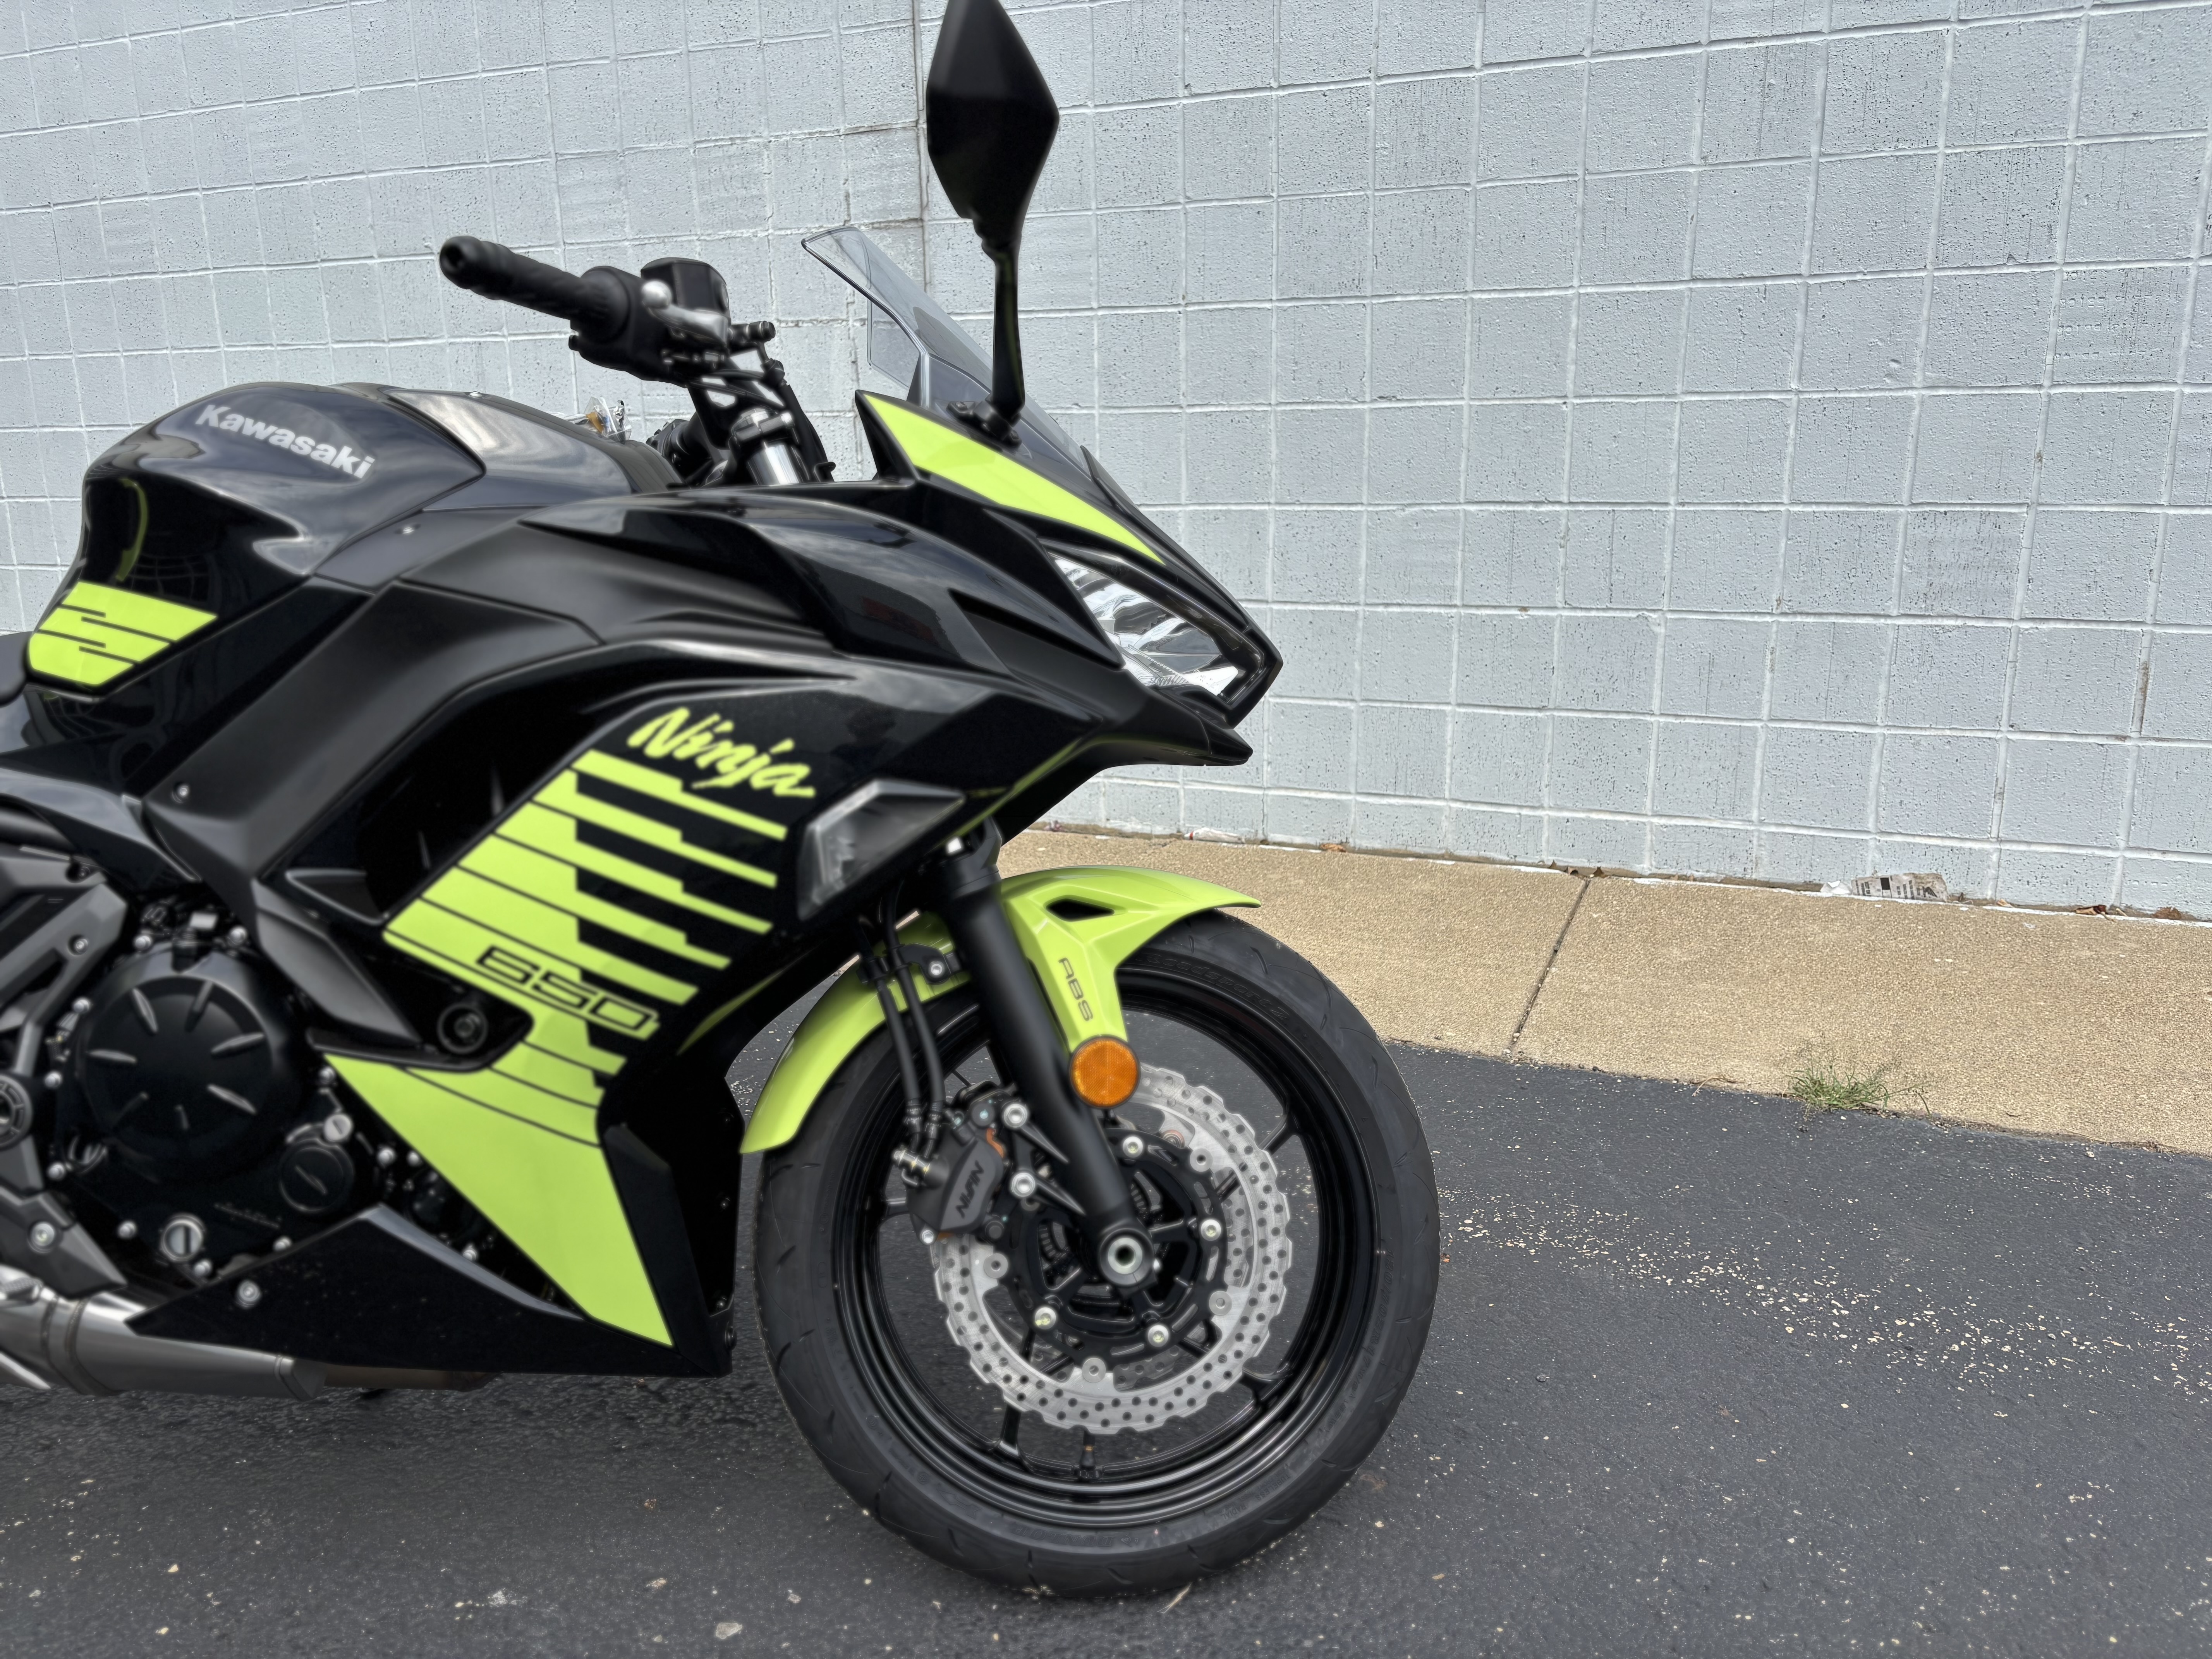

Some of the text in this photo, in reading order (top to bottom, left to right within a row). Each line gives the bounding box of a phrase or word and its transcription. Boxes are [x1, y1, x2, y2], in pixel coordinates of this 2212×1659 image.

[196, 405, 375, 479] Kawasaki
[627, 707, 816, 798] Ninja
[476, 945, 656, 1032] 650
[1058, 957, 1093, 1021] ABS
